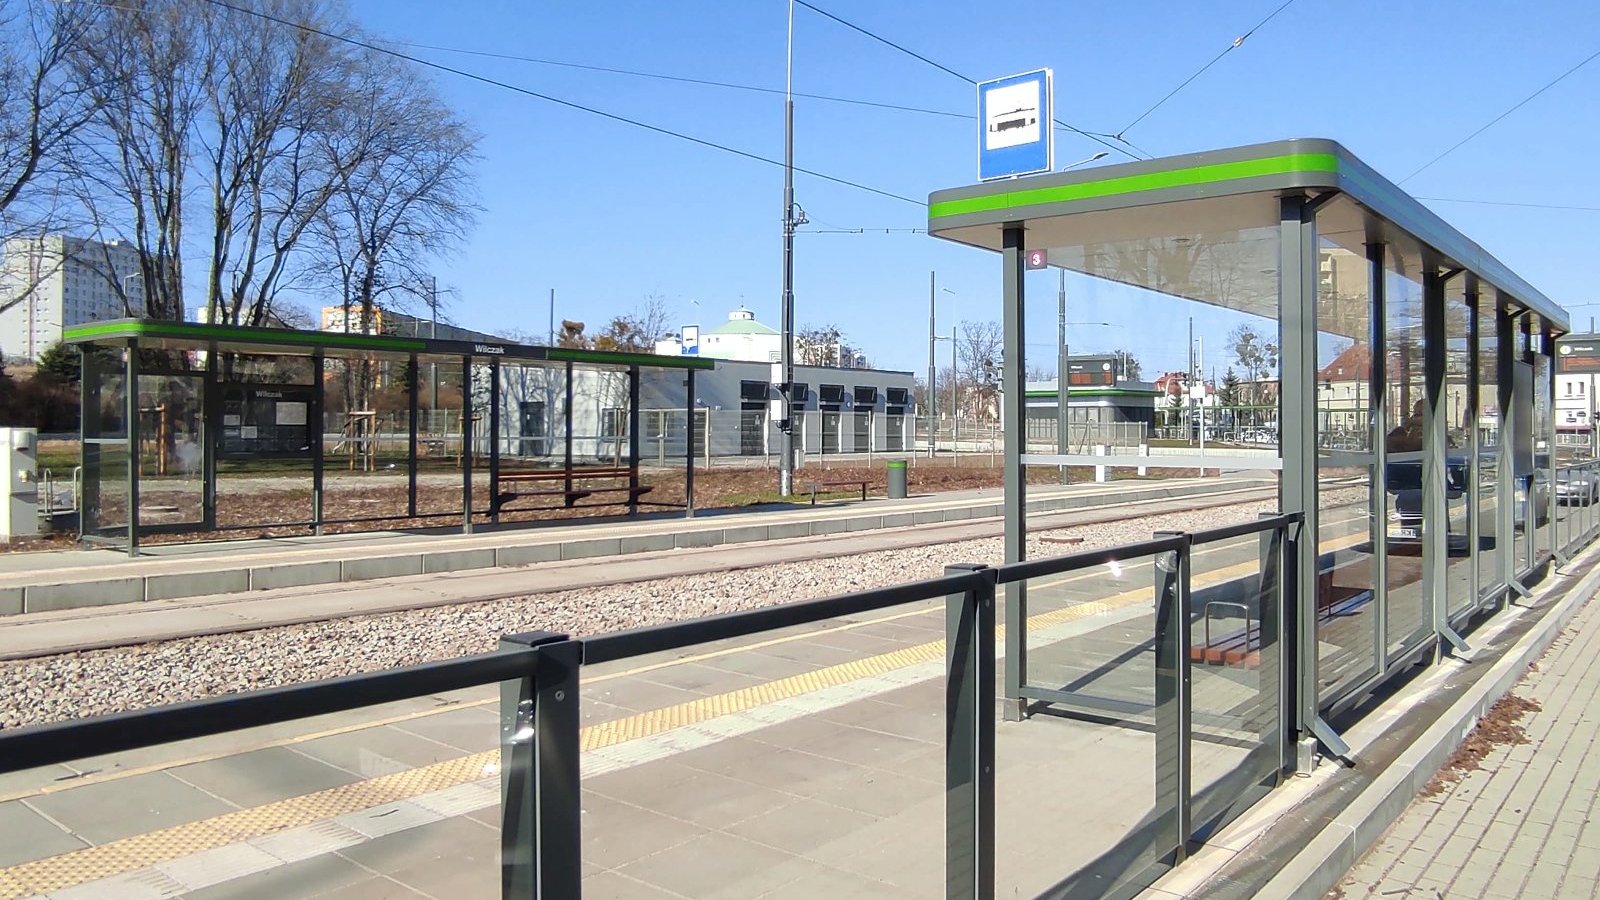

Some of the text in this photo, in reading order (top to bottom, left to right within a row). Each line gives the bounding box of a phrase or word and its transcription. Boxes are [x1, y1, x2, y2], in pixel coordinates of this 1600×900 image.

[1032, 253, 1041, 266] 3
[474, 344, 505, 355] Wilczak
[255, 390, 283, 398] Wilczak
